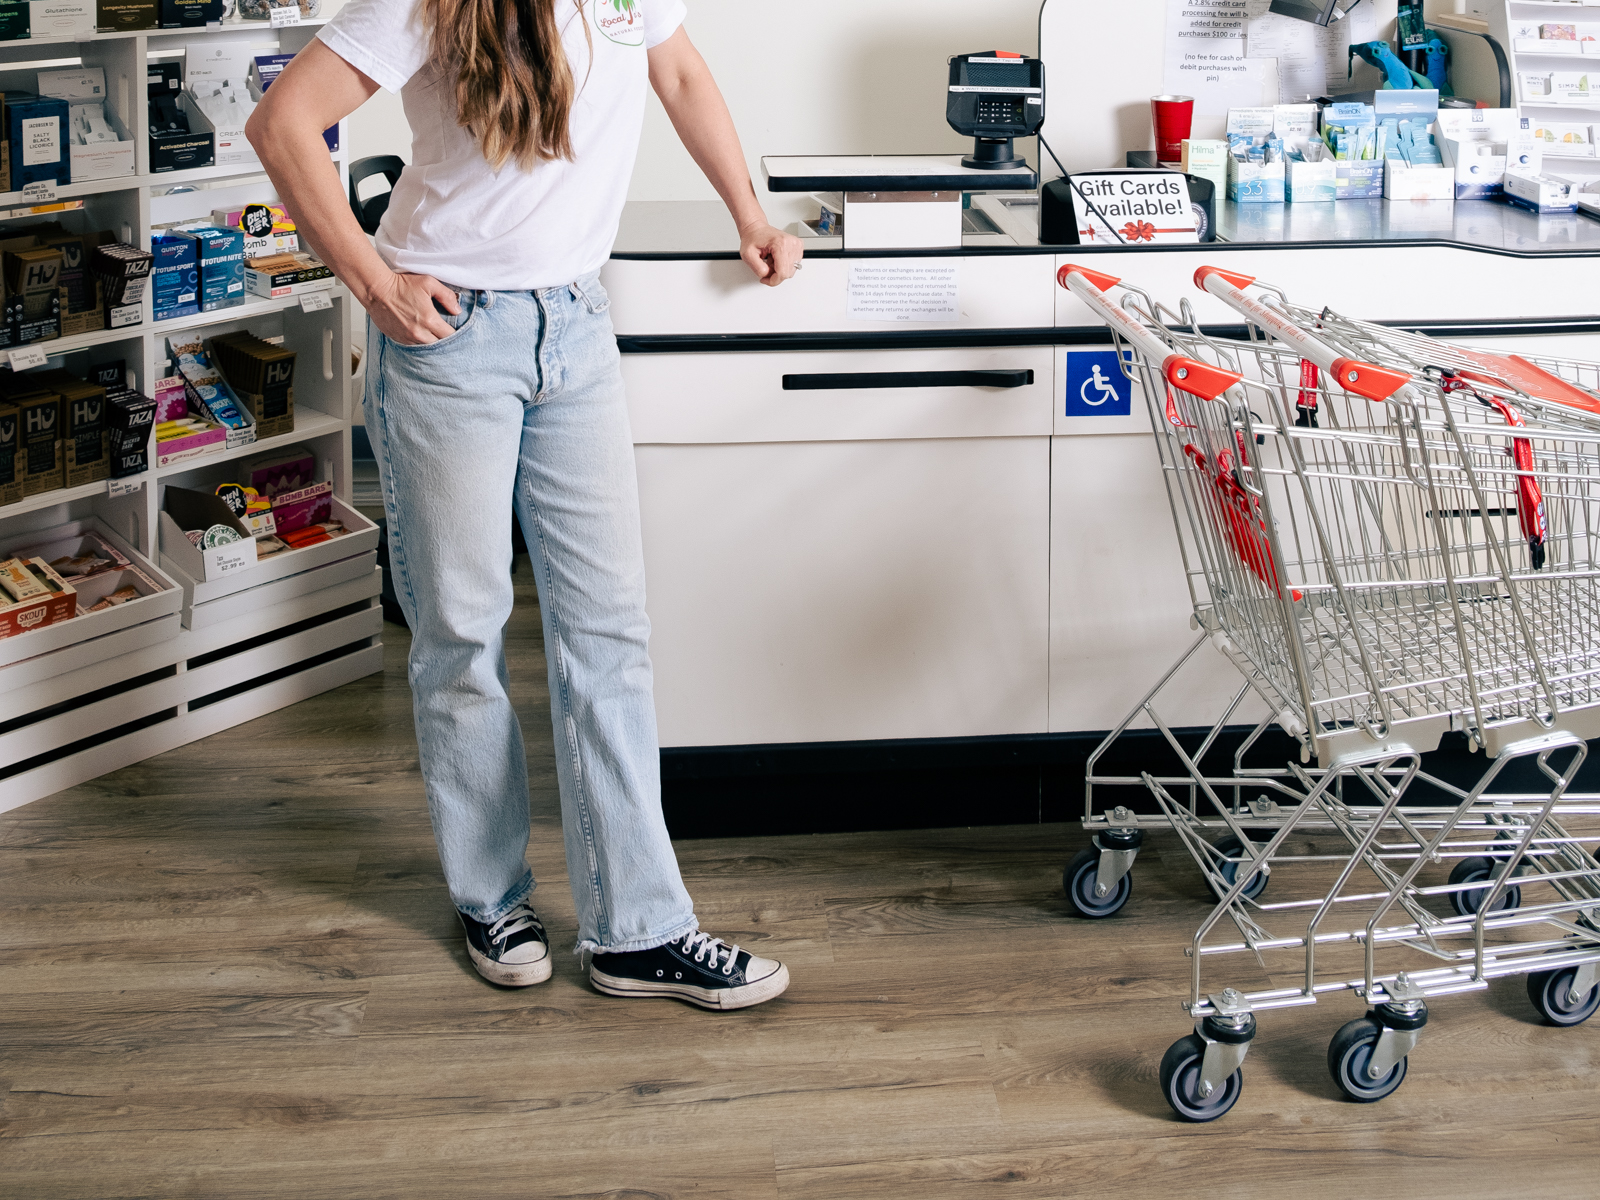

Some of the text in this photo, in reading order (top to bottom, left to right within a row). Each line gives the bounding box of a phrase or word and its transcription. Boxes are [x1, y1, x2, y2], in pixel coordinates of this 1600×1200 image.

[601, 14, 626, 28] Local
[610, 28, 633, 37] NATURAL
[159, 141, 186, 150] Activated
[1191, 145, 1215, 154] Hilma
[1350, 168, 1373, 176] BrainON
[1079, 179, 1180, 196] Gift Cards
[1242, 180, 1263, 196] 3.3
[1295, 181, 1317, 196] 0.9
[1085, 199, 1183, 216] Available!
[209, 237, 235, 245] QUINTON
[161, 244, 188, 253] QUINTON
[206, 253, 242, 265] TOTUM NITE
[125, 260, 149, 275] TAZA
[98, 368, 119, 382] TAZA
[128, 410, 153, 426] TAZA
[74, 430, 100, 444] SIMPLE
[123, 437, 140, 445] WICKED
[122, 454, 142, 468] TAZA
[69, 466, 89, 474] ORGANIC
[280, 484, 326, 504] BOMB BARS
[221, 561, 237, 571] $2.99
[19, 608, 46, 623] SKOUT
